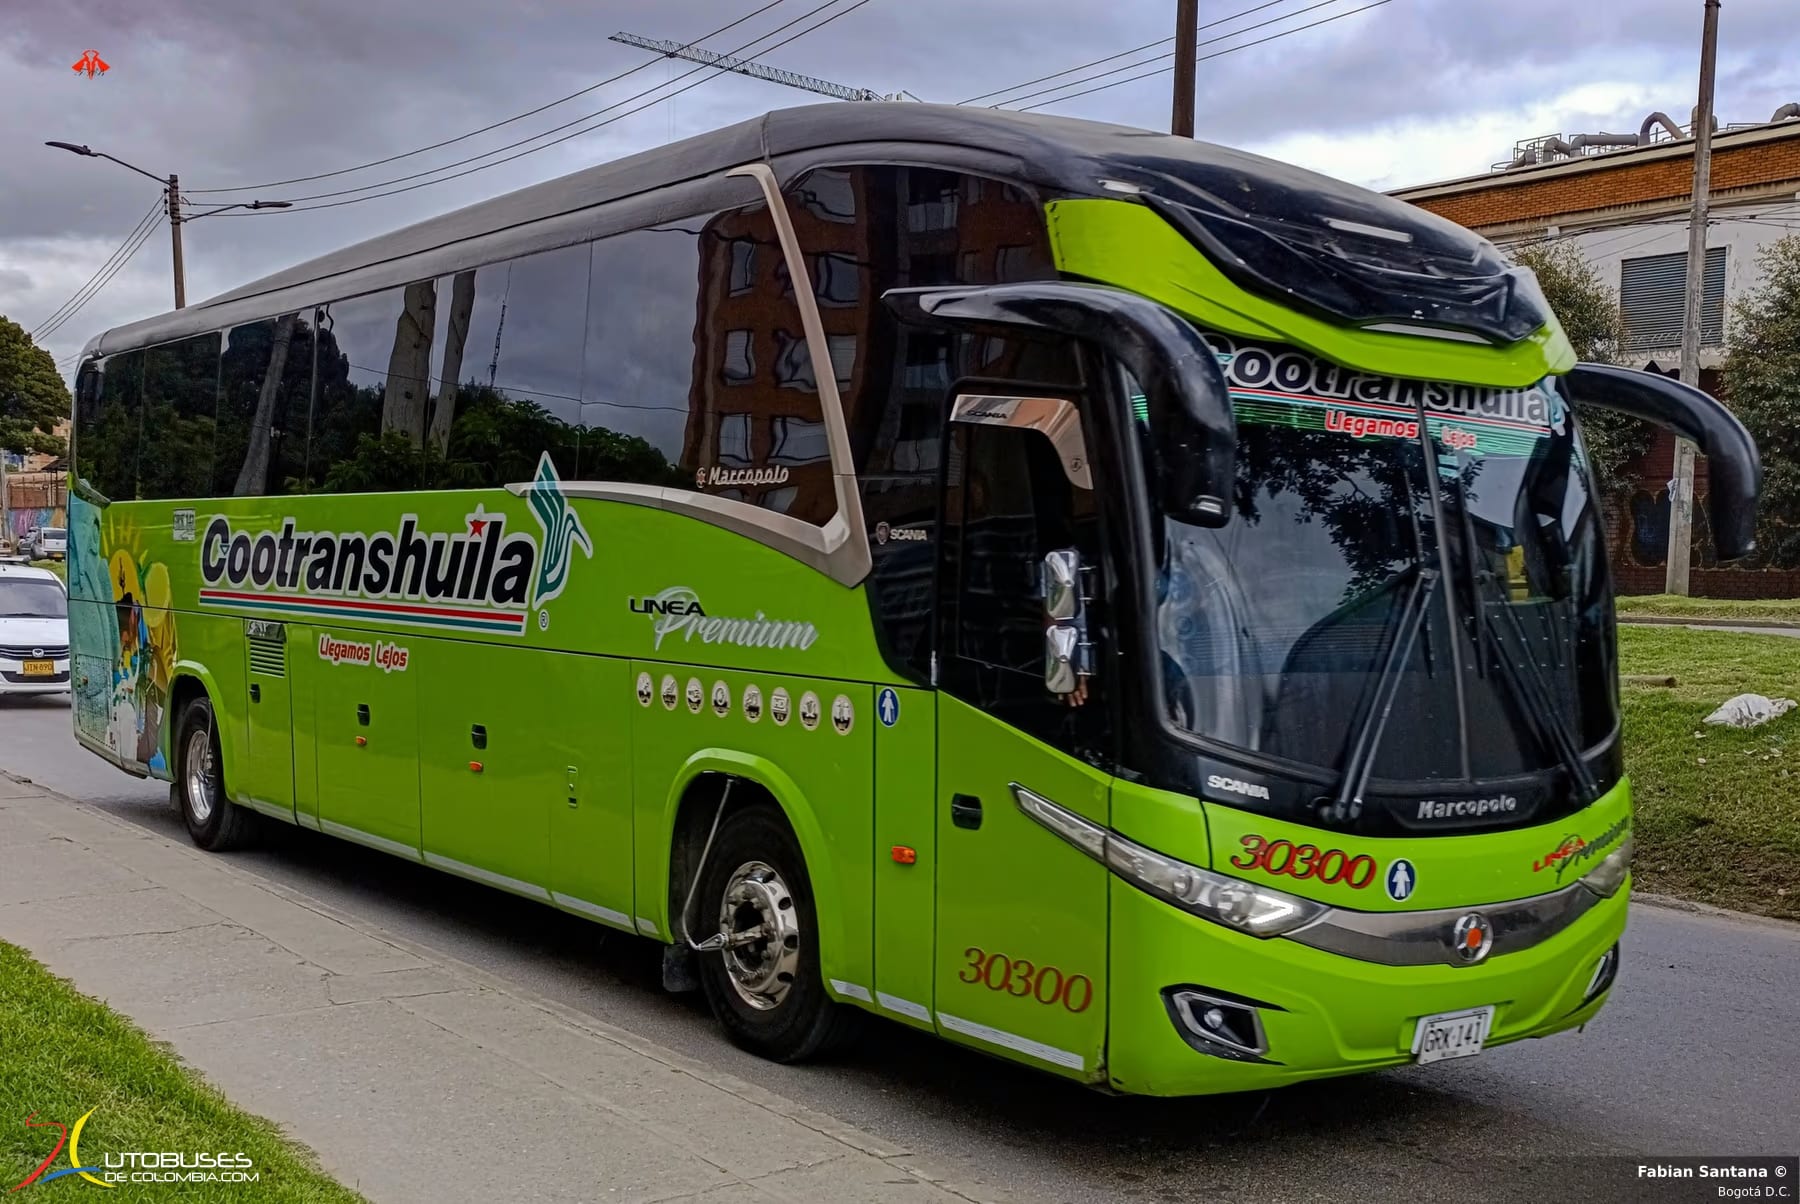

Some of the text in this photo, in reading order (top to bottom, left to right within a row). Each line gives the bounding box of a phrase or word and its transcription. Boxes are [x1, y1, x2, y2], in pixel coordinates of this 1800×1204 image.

[1324, 410, 1477, 450] Llegamos Lejos
[708, 464, 790, 486] Marcopolo
[890, 528, 928, 541] SCANIA
[201, 514, 536, 605] Cootranshuila
[629, 598, 705, 617] LINEA
[649, 586, 818, 651] Premium
[319, 634, 408, 672] Llegamos Lejos
[1207, 774, 1270, 801] SCANIA
[1418, 795, 1517, 819] Marcopolo
[1231, 834, 1377, 890] 30300
[958, 946, 1093, 1014] 30300
